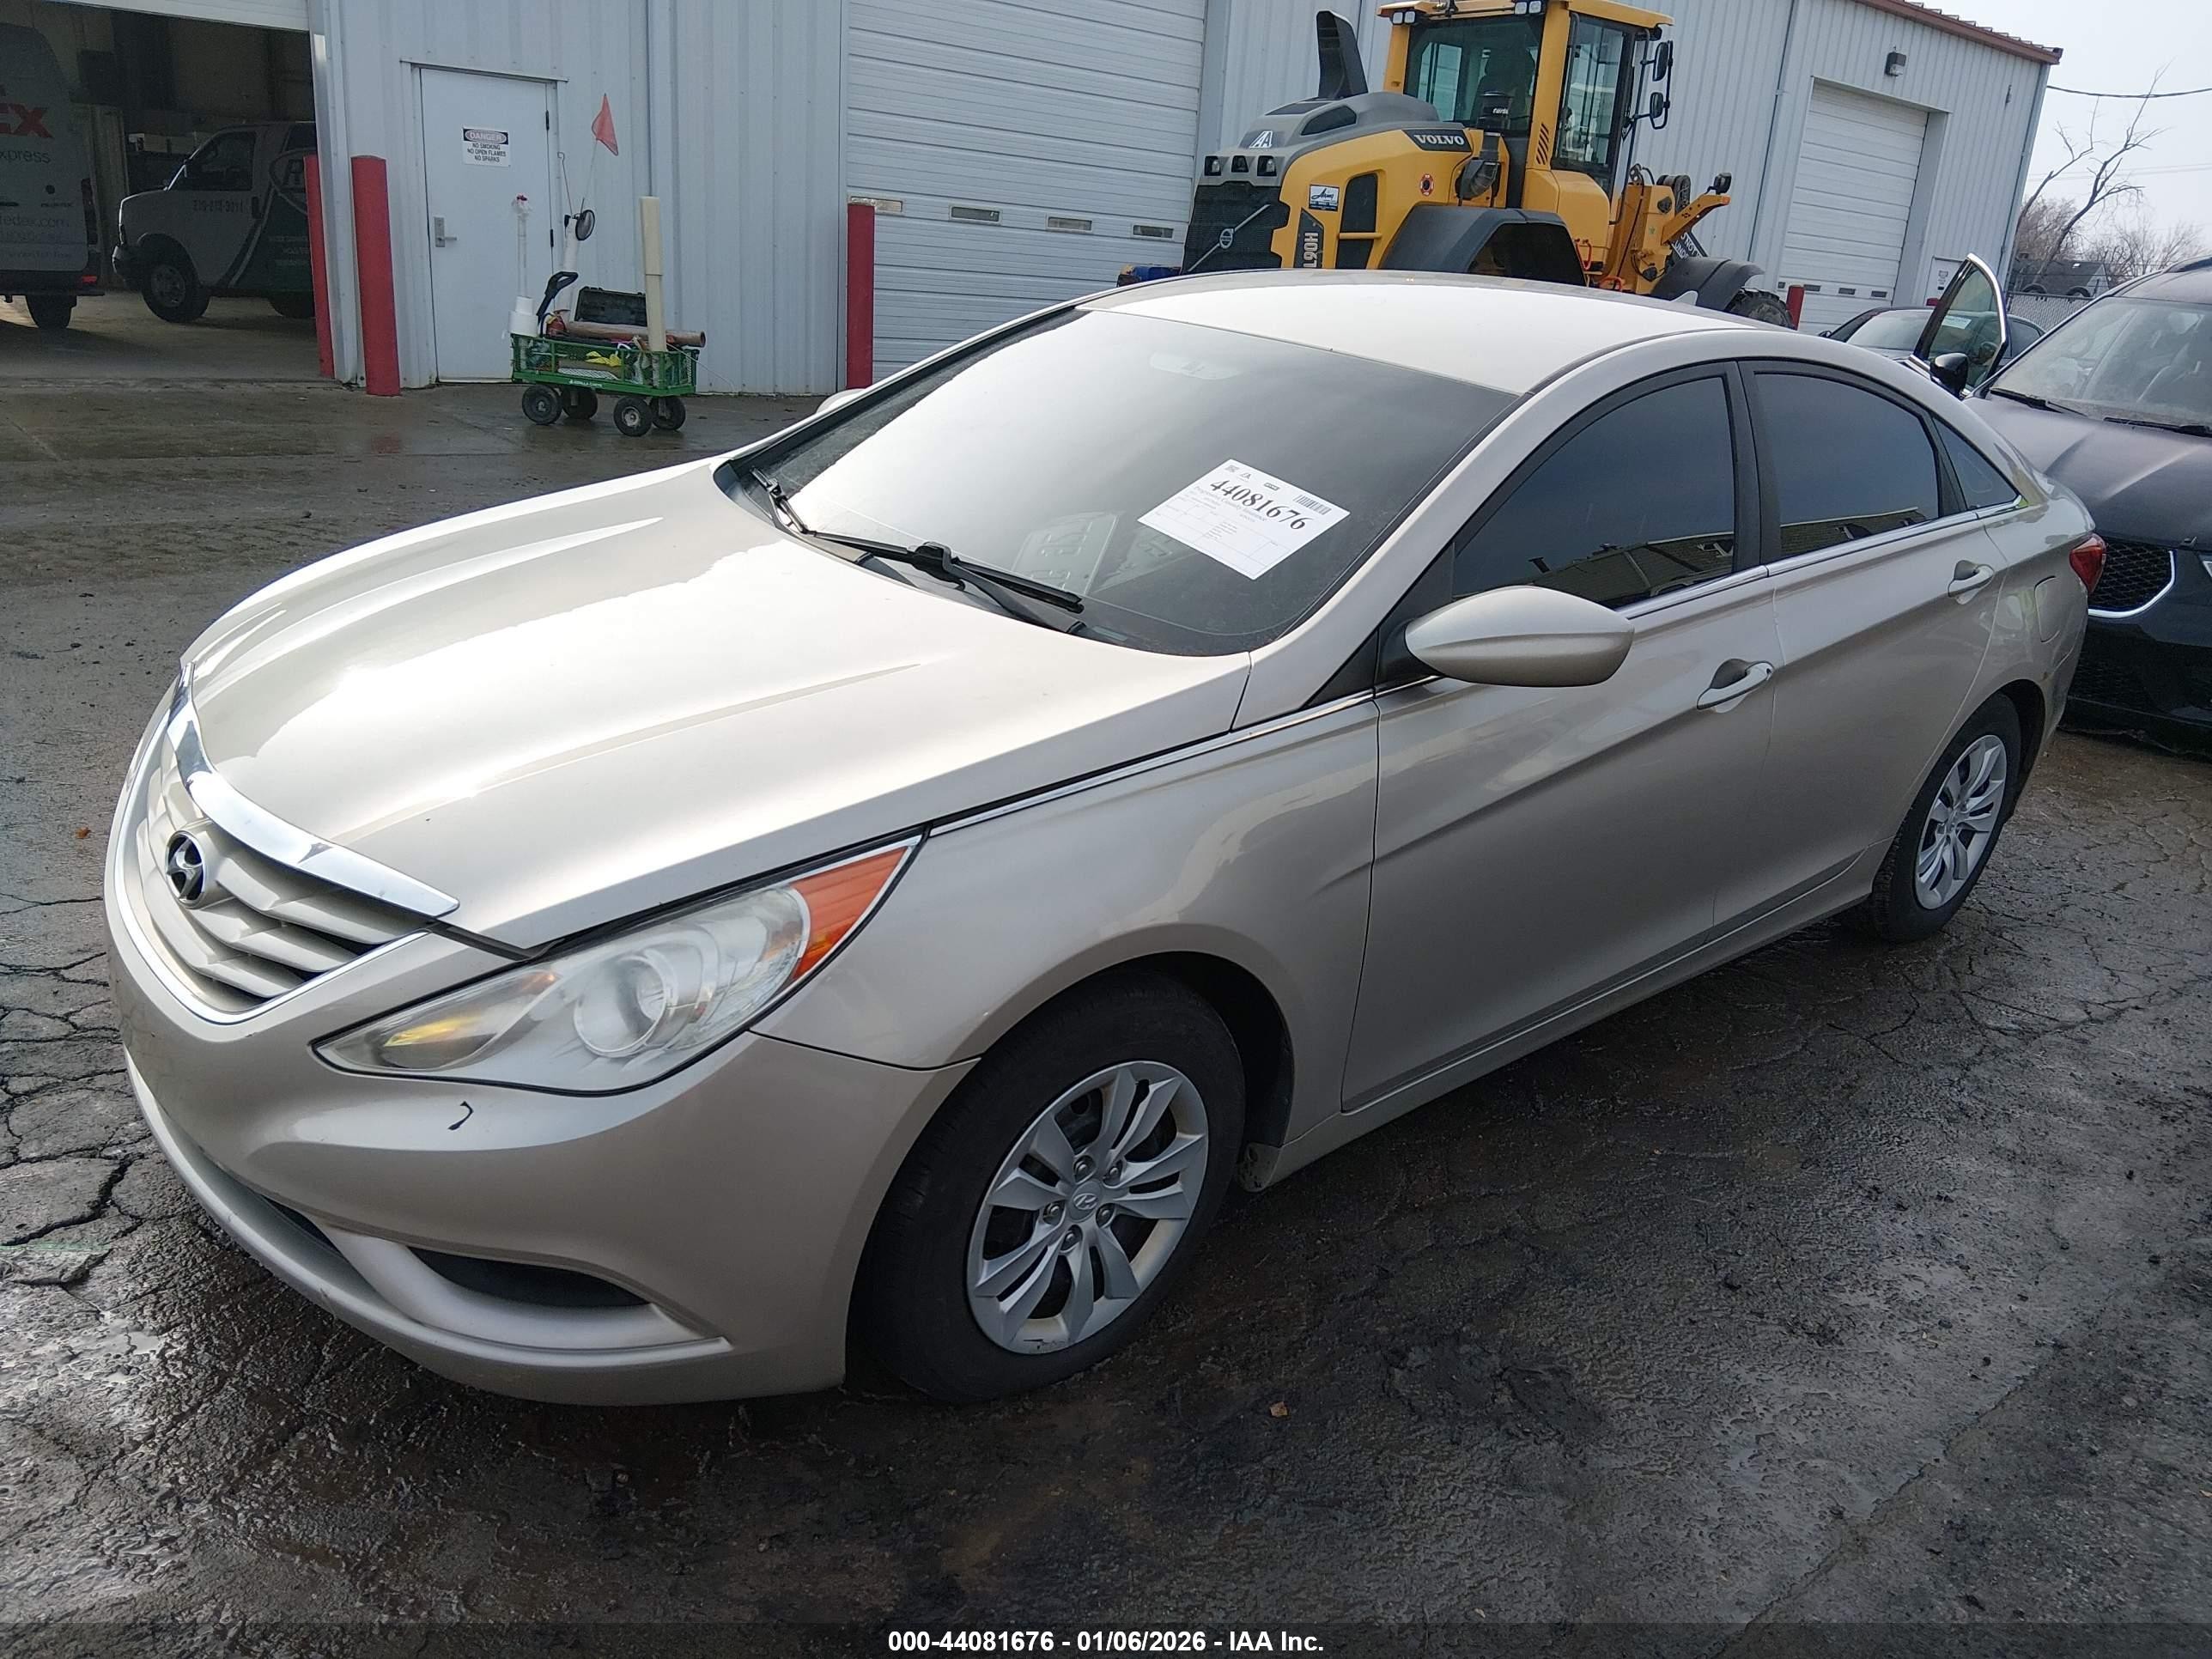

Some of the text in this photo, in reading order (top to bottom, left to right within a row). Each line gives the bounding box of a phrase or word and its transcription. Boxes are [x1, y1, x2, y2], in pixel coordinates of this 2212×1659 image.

[470, 131, 504, 141] DANGER
[1413, 134, 1465, 145] VOLVO
[1303, 232, 1319, 268] L90H
[1685, 238, 1698, 256] NOT
[1210, 480, 1313, 530] 44081676
